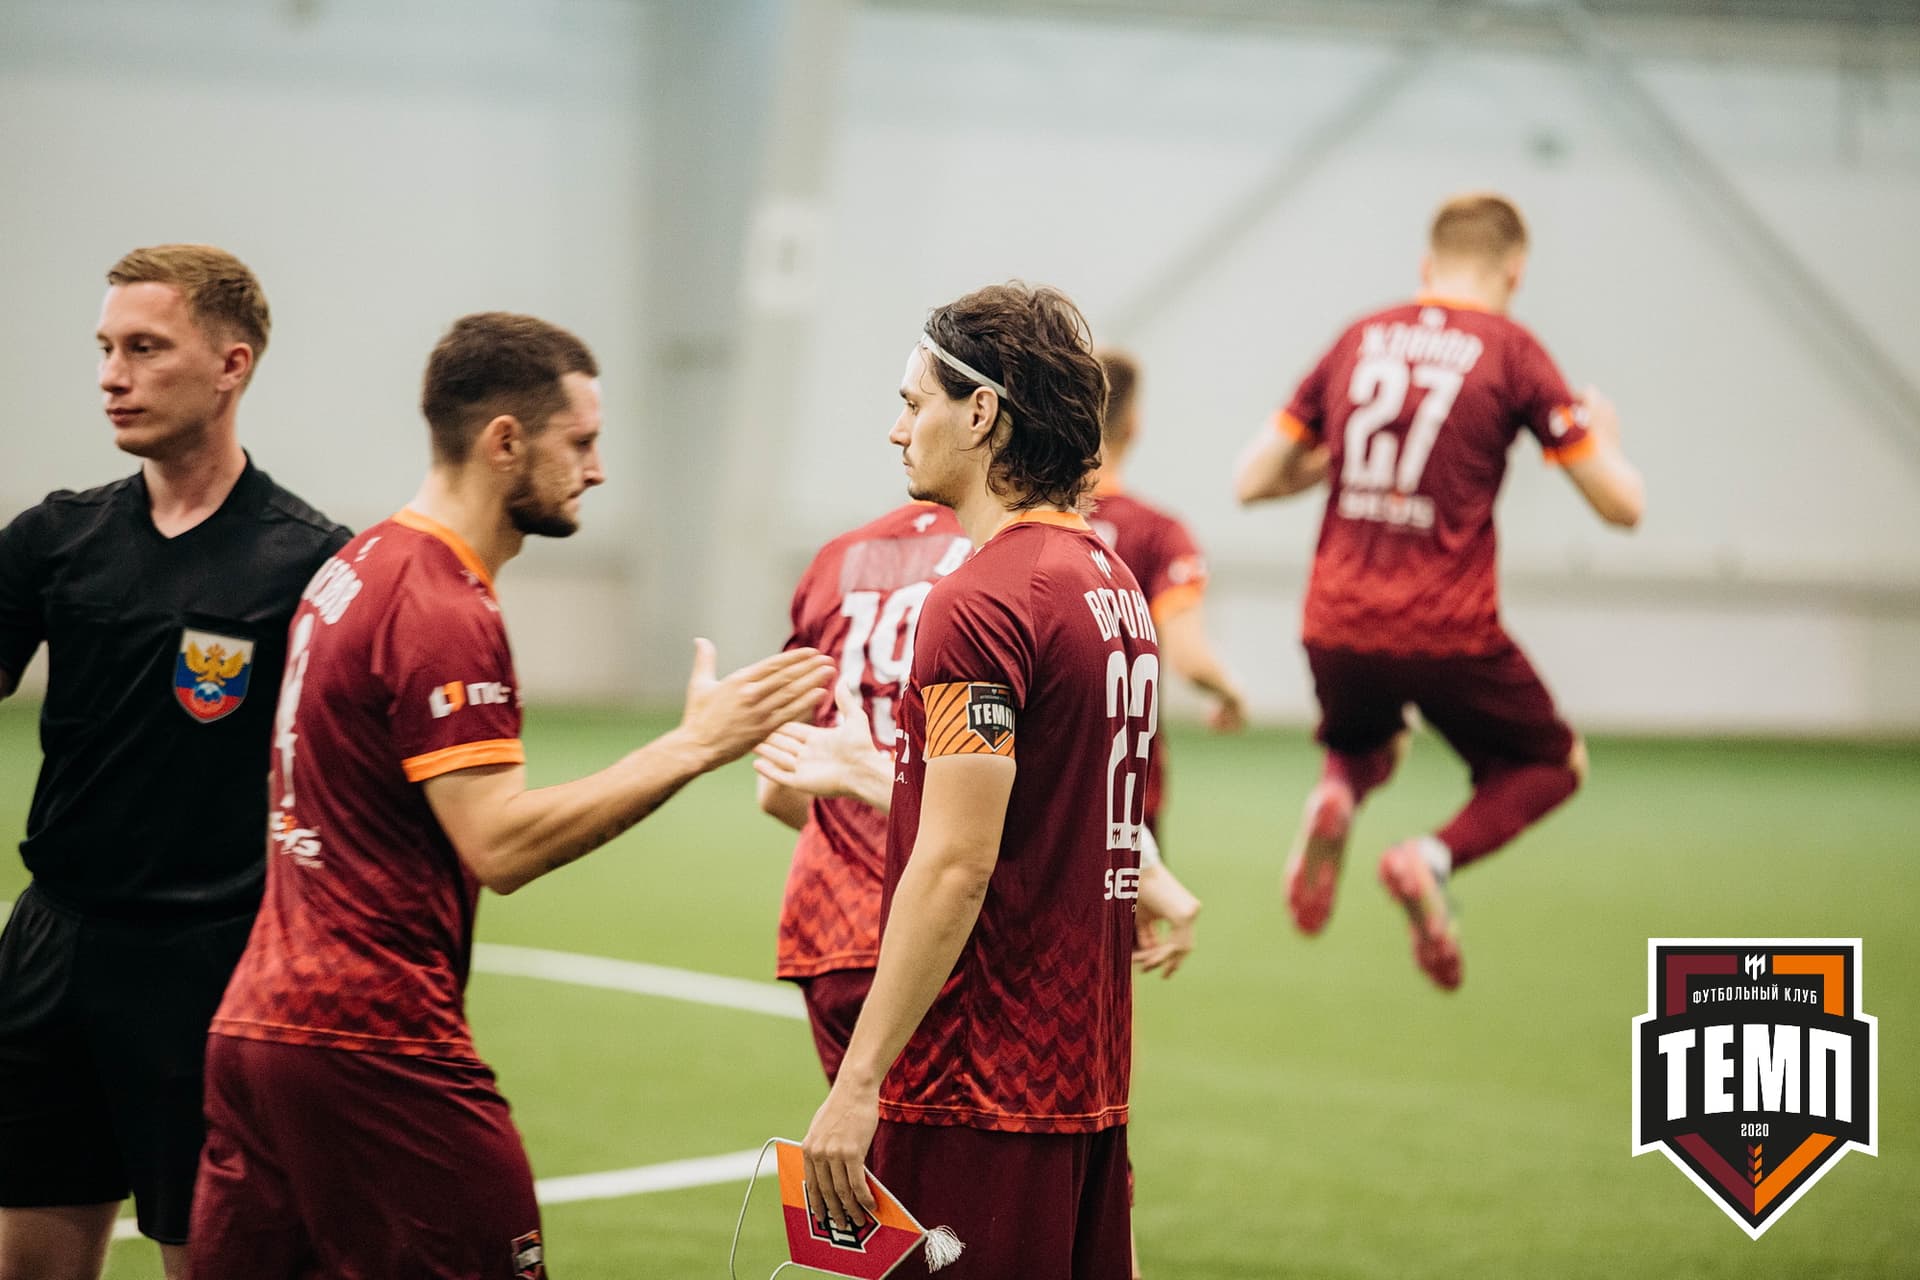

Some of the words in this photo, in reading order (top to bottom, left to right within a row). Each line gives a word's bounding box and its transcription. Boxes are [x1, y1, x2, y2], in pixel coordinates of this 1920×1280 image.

[1341, 361, 1464, 494] 27
[841, 582, 934, 746] 19
[1084, 587, 1158, 647] ВОРОН
[972, 703, 1013, 730] ТЕМП
[1106, 650, 1159, 851] 23
